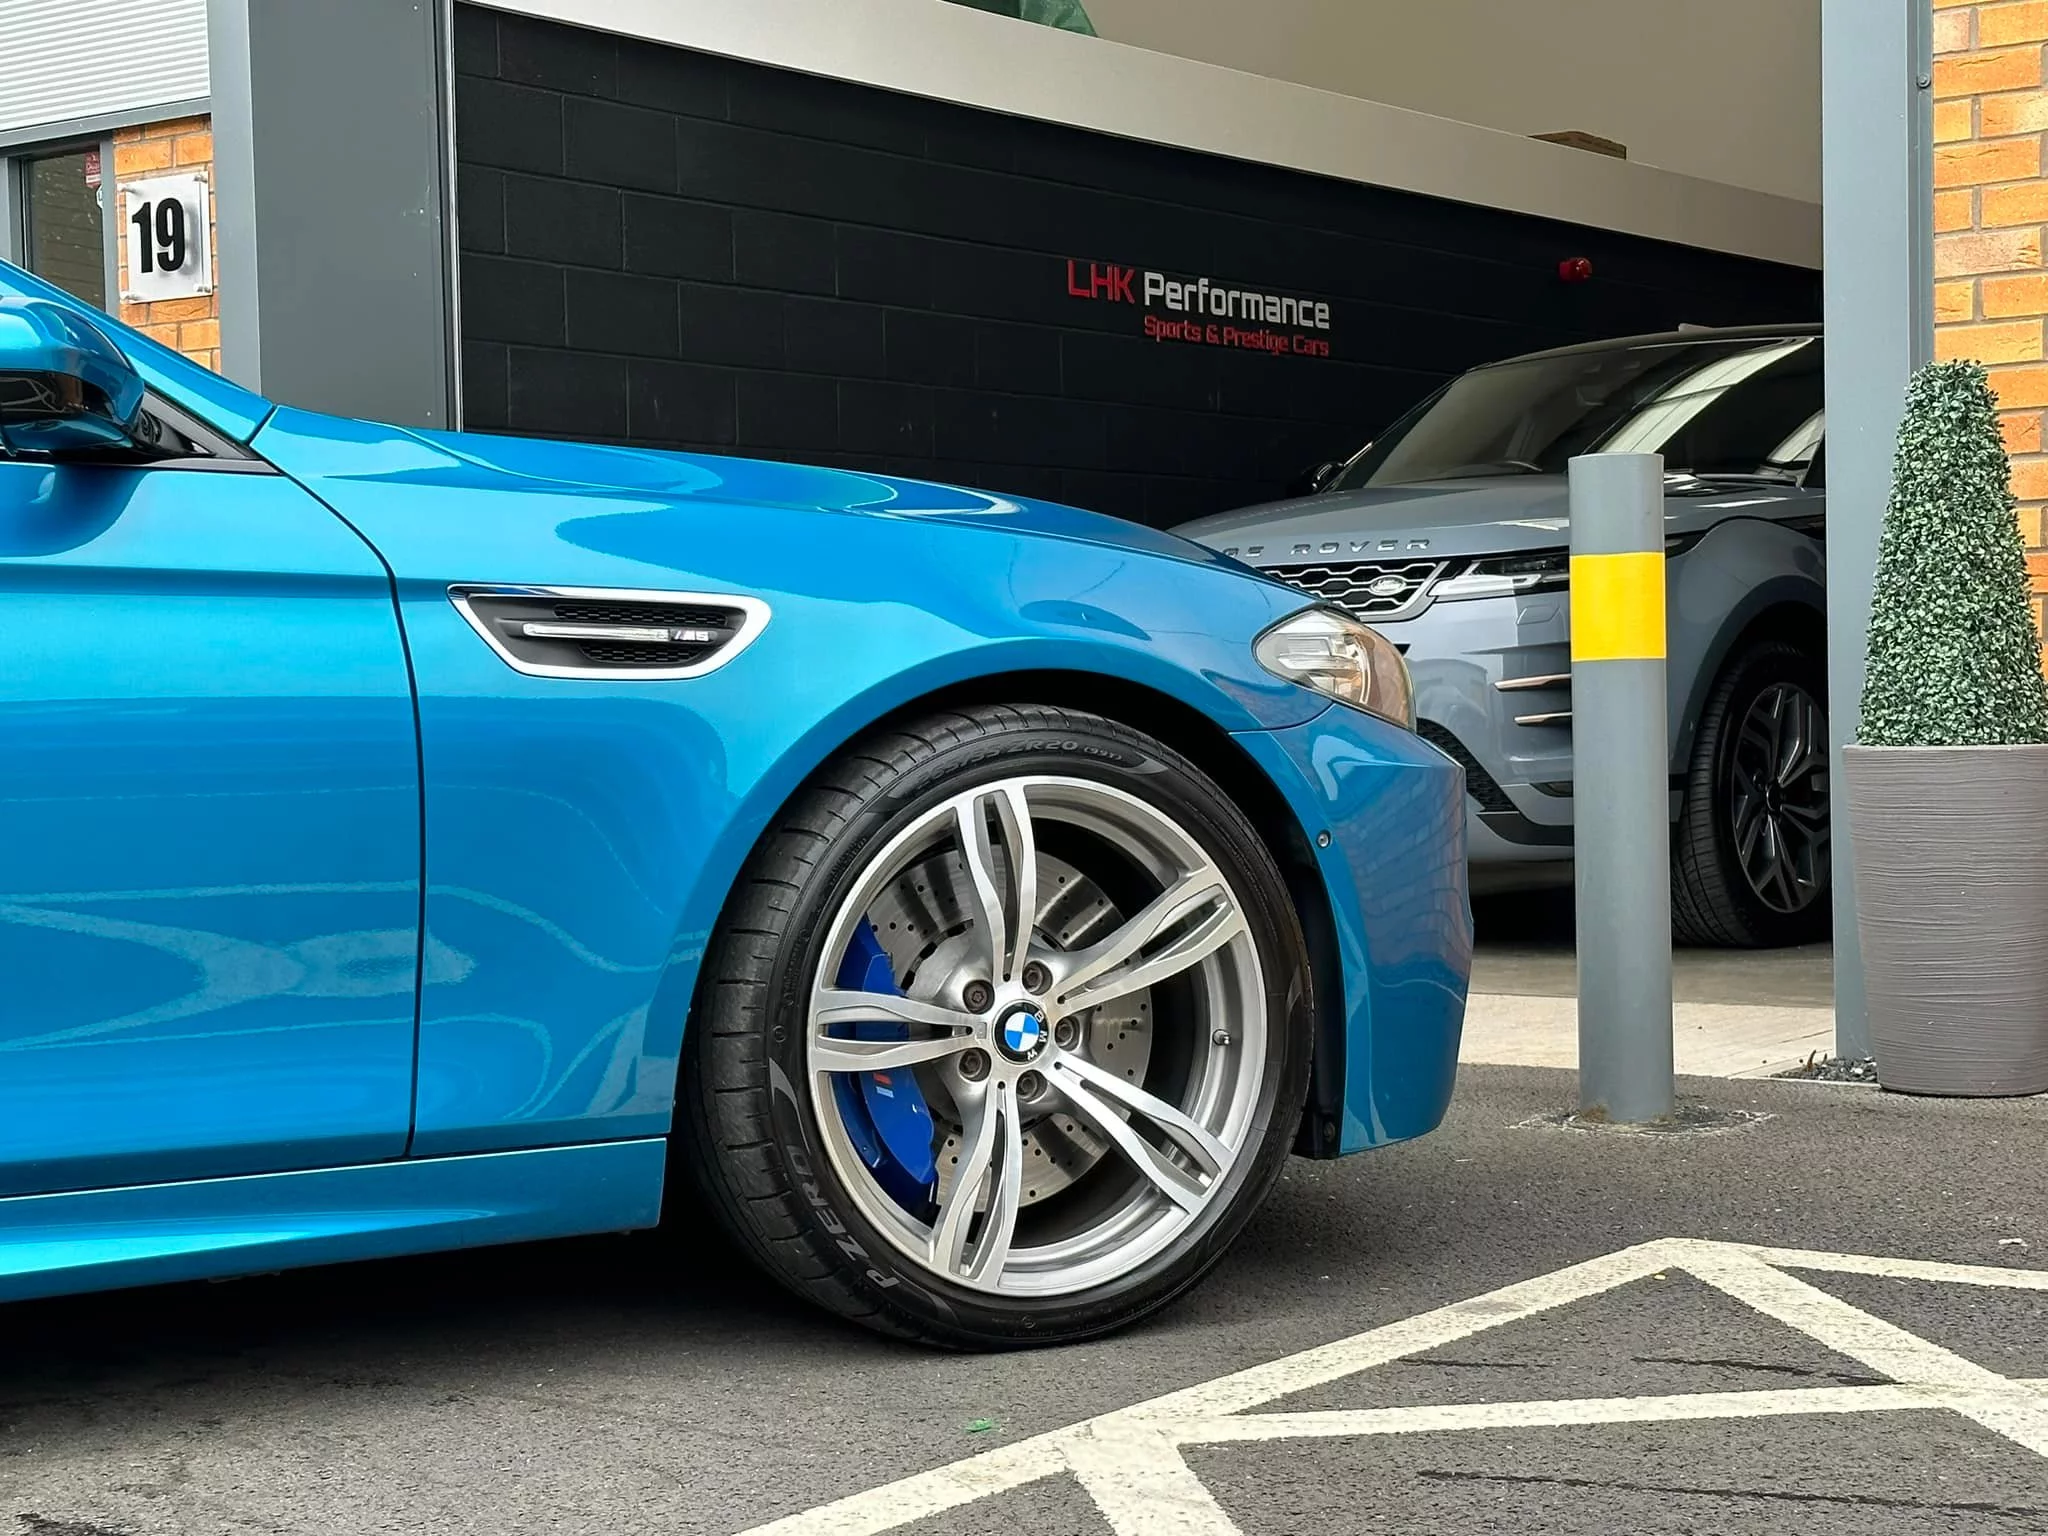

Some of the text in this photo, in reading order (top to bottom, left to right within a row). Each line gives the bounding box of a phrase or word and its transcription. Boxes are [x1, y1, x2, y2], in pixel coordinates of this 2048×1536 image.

[131, 197, 186, 274] 19
[1066, 259, 1331, 330] LHK Performance
[1144, 315, 1330, 356] Sports & Prestige Cars
[1290, 538, 1430, 556] ROVER
[1027, 1010, 1048, 1061] BMW
